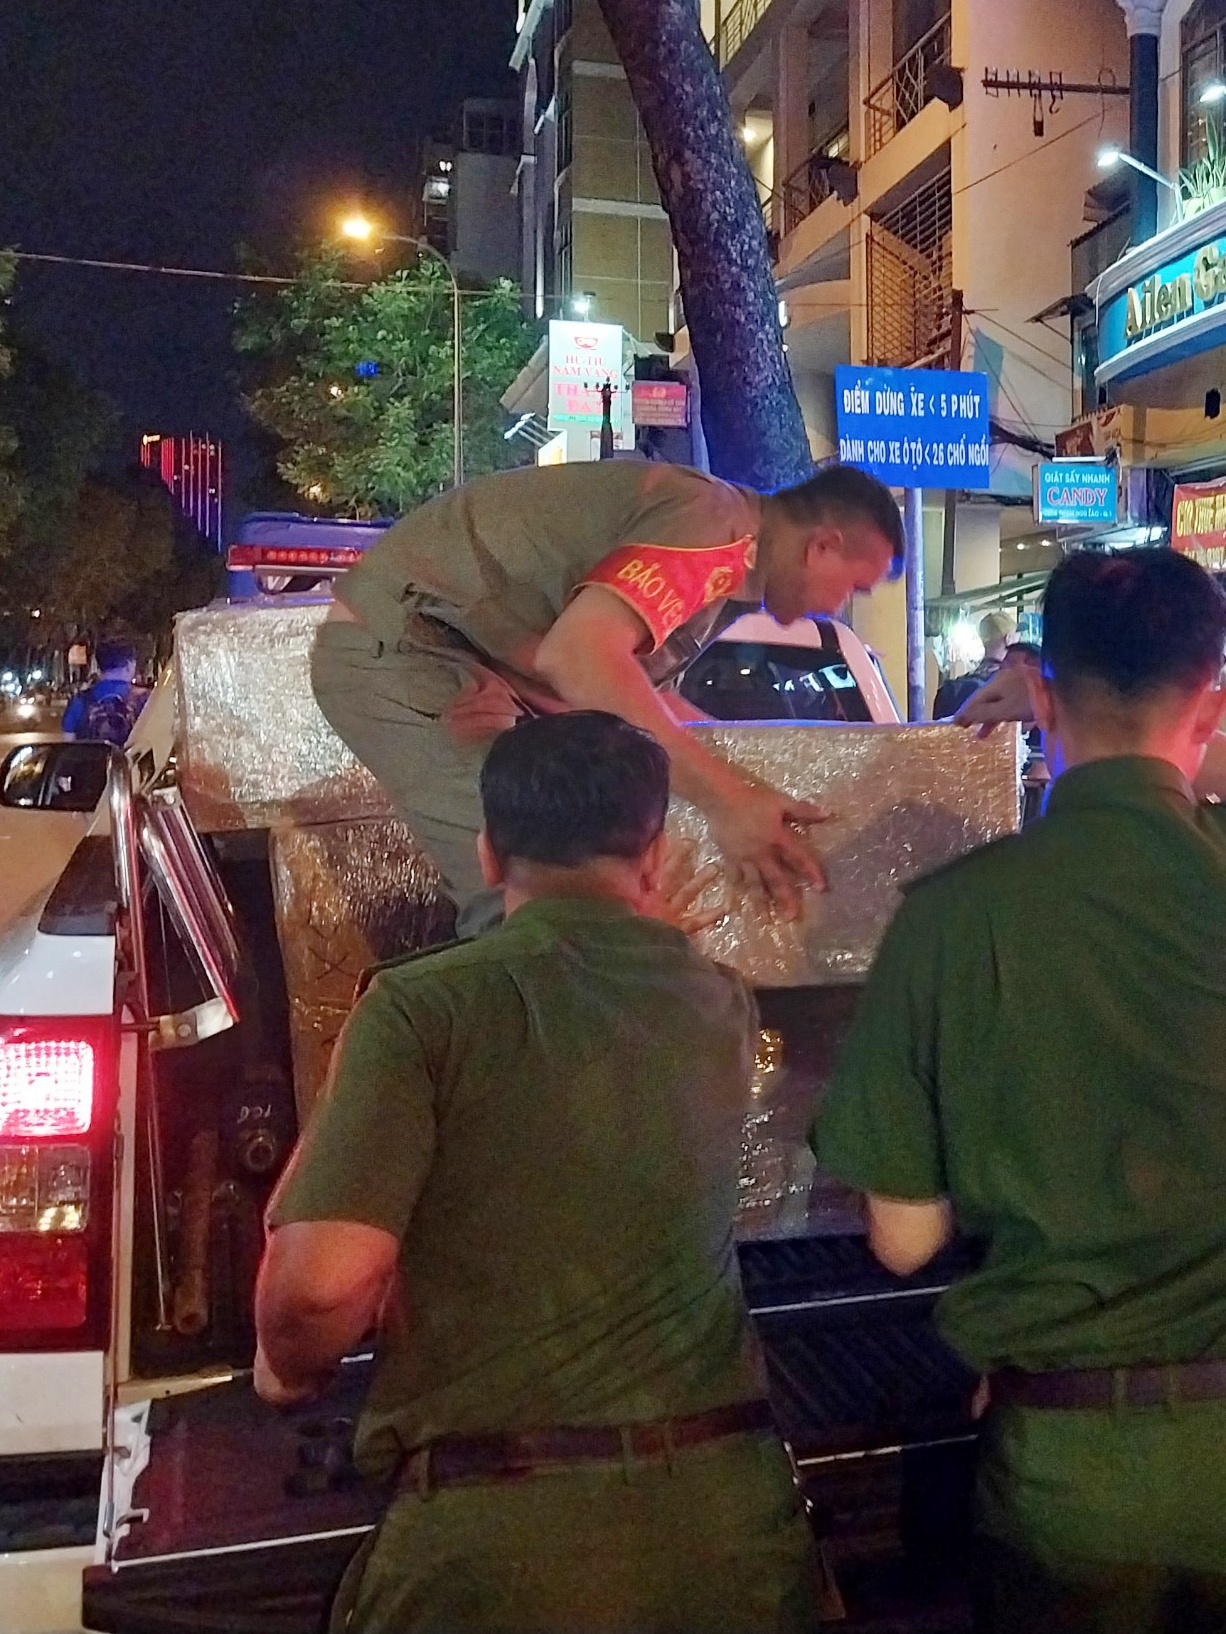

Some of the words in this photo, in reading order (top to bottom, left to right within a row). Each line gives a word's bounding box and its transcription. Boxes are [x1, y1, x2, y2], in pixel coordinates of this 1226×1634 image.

[843, 379, 870, 414] ĐIỂM
[876, 384, 904, 416] DỪNG
[941, 394, 947, 417] 5
[952, 389, 980, 418] PHÚT
[840, 434, 864, 462] DÀNH
[867, 440, 886, 463] CHO
[889, 441, 900, 464] XE
[932, 442, 944, 466] 26
[1082, 473, 1110, 484] NHANH
[1047, 486, 1108, 506] CANDY
[617, 559, 665, 598] BẢO
